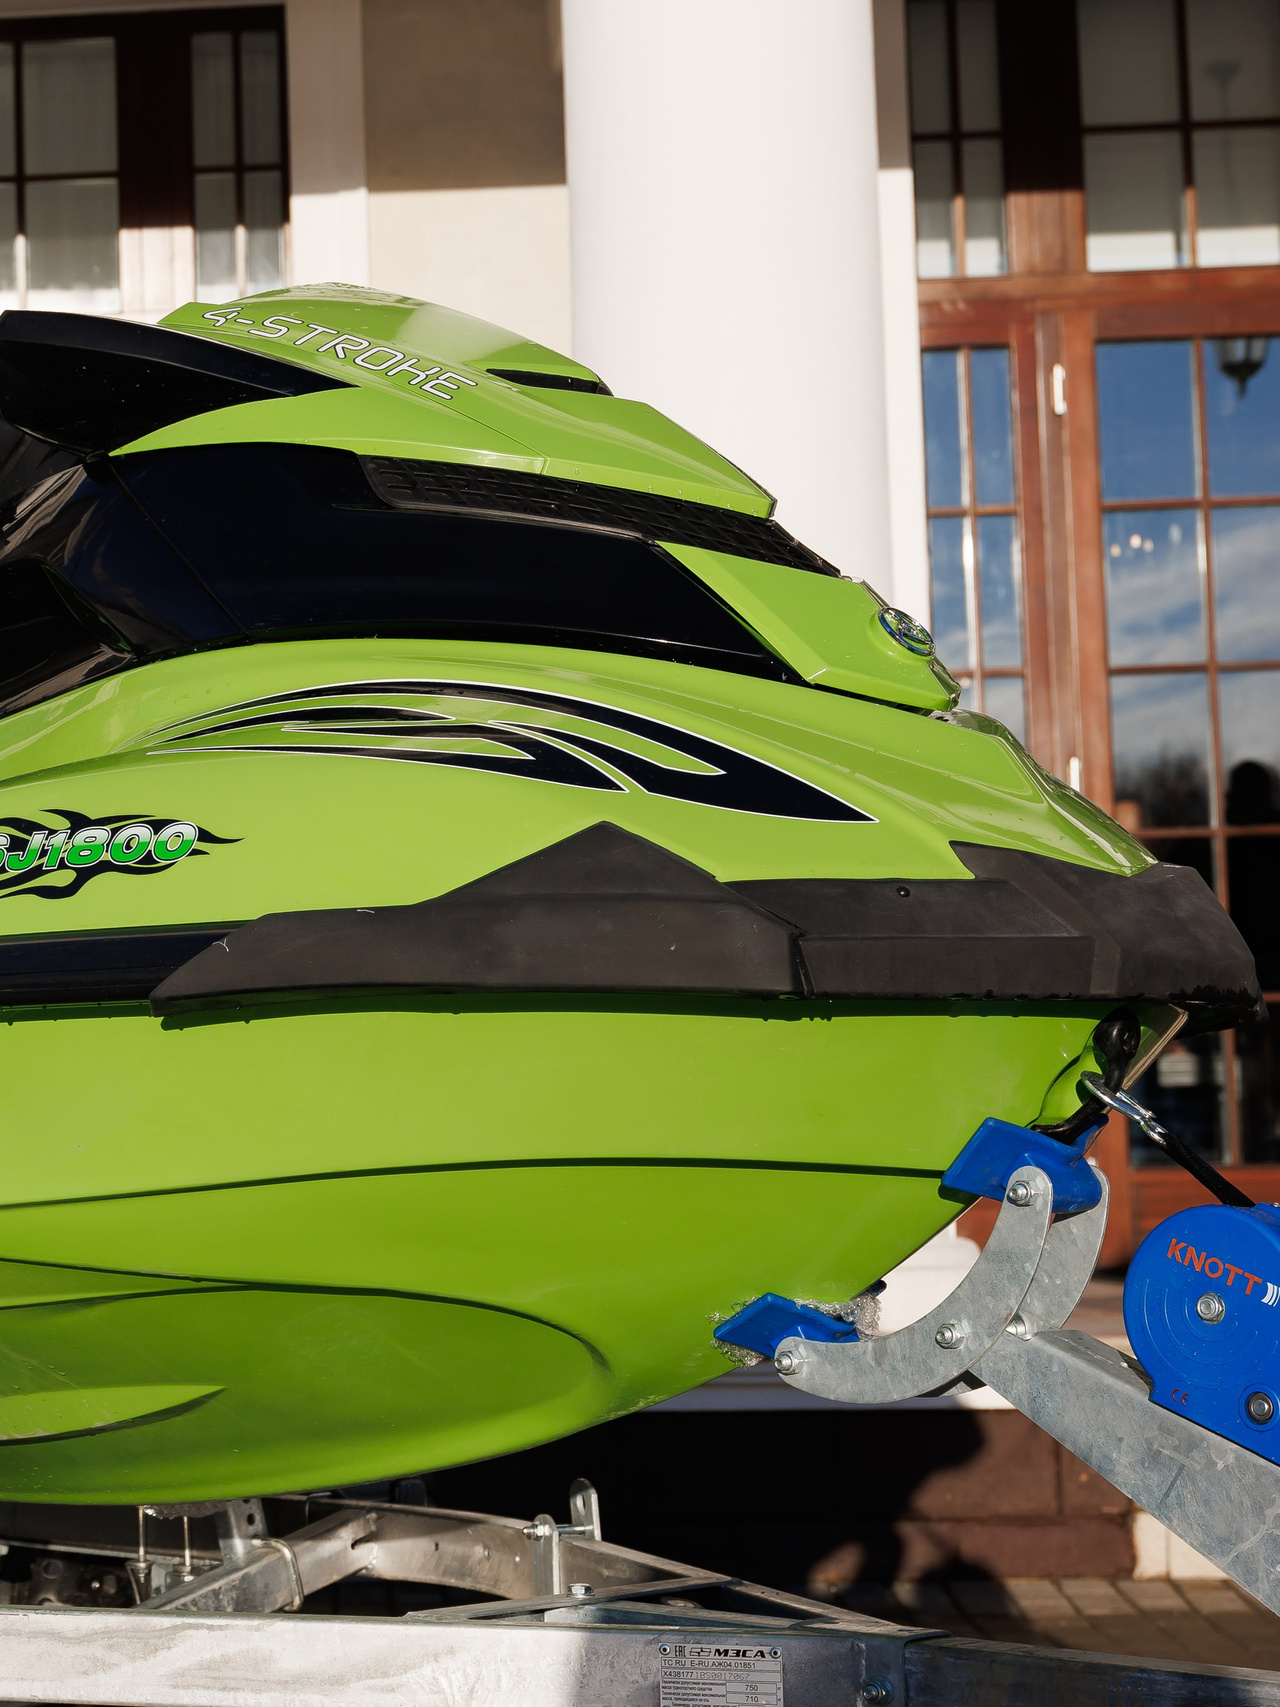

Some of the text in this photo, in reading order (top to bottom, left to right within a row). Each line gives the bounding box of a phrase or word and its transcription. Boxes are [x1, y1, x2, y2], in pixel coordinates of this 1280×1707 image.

[202, 307, 478, 400] 4-STROKE
[1166, 1237, 1263, 1295] KNOTT
[745, 1684, 759, 1692] 750
[745, 1695, 759, 1703] 710
